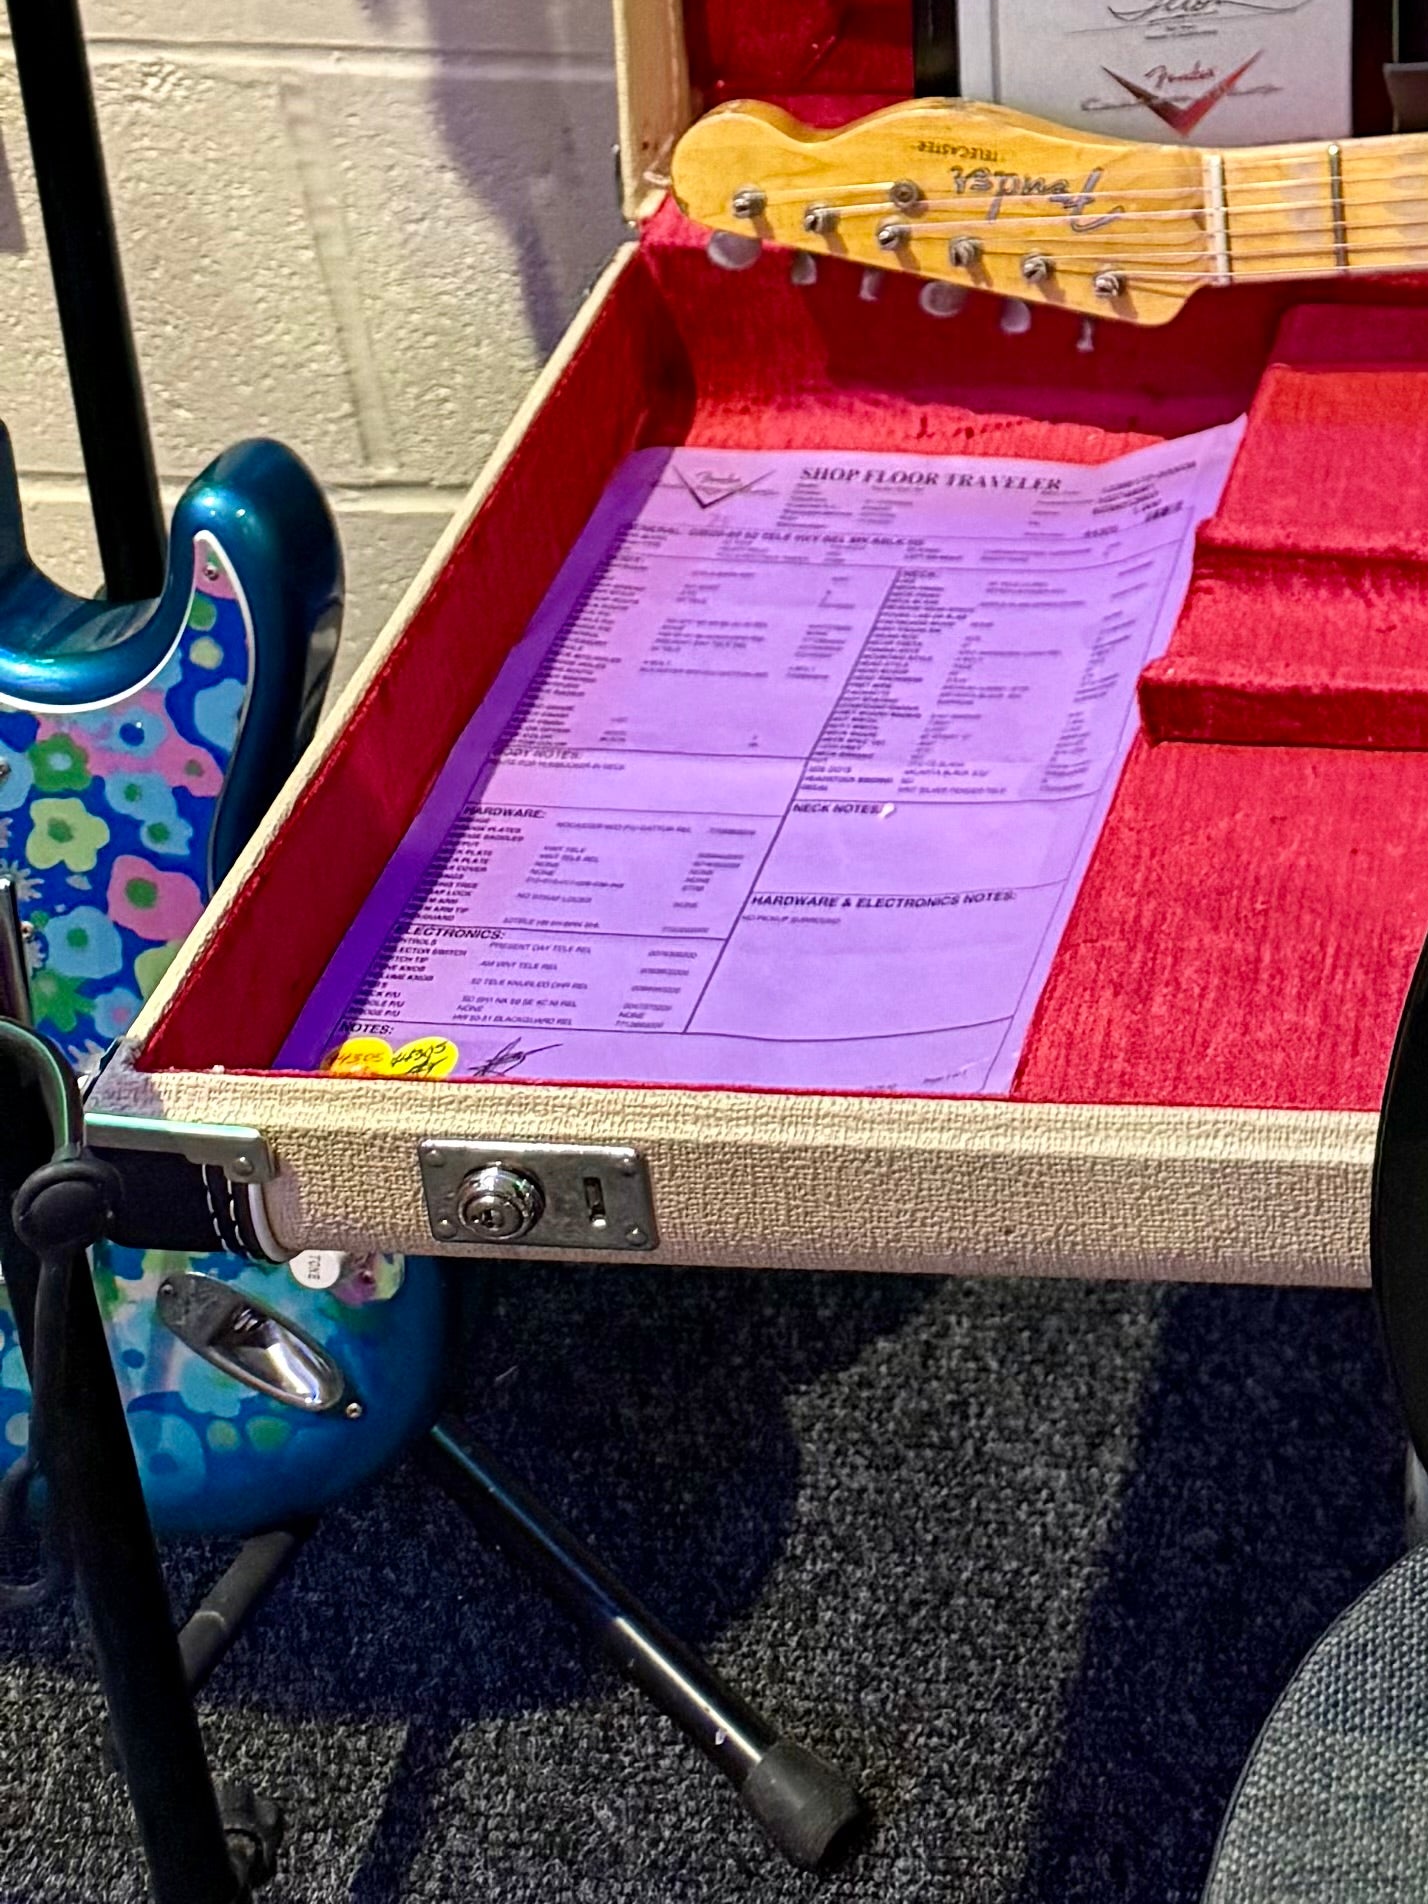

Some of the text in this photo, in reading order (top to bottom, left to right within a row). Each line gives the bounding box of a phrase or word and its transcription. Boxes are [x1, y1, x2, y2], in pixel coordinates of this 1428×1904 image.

[799, 466, 861, 484] SHOP
[863, 468, 940, 486] FLOOR
[945, 472, 1062, 491] TRAVELER
[463, 805, 547, 818] HARDWARE:
[792, 803, 830, 814] NECK
[750, 895, 838, 908] HARDWARE
[856, 894, 959, 908] ELECTRONICS
[963, 890, 1016, 903] NOTES:
[307, 1254, 321, 1281] TONE
